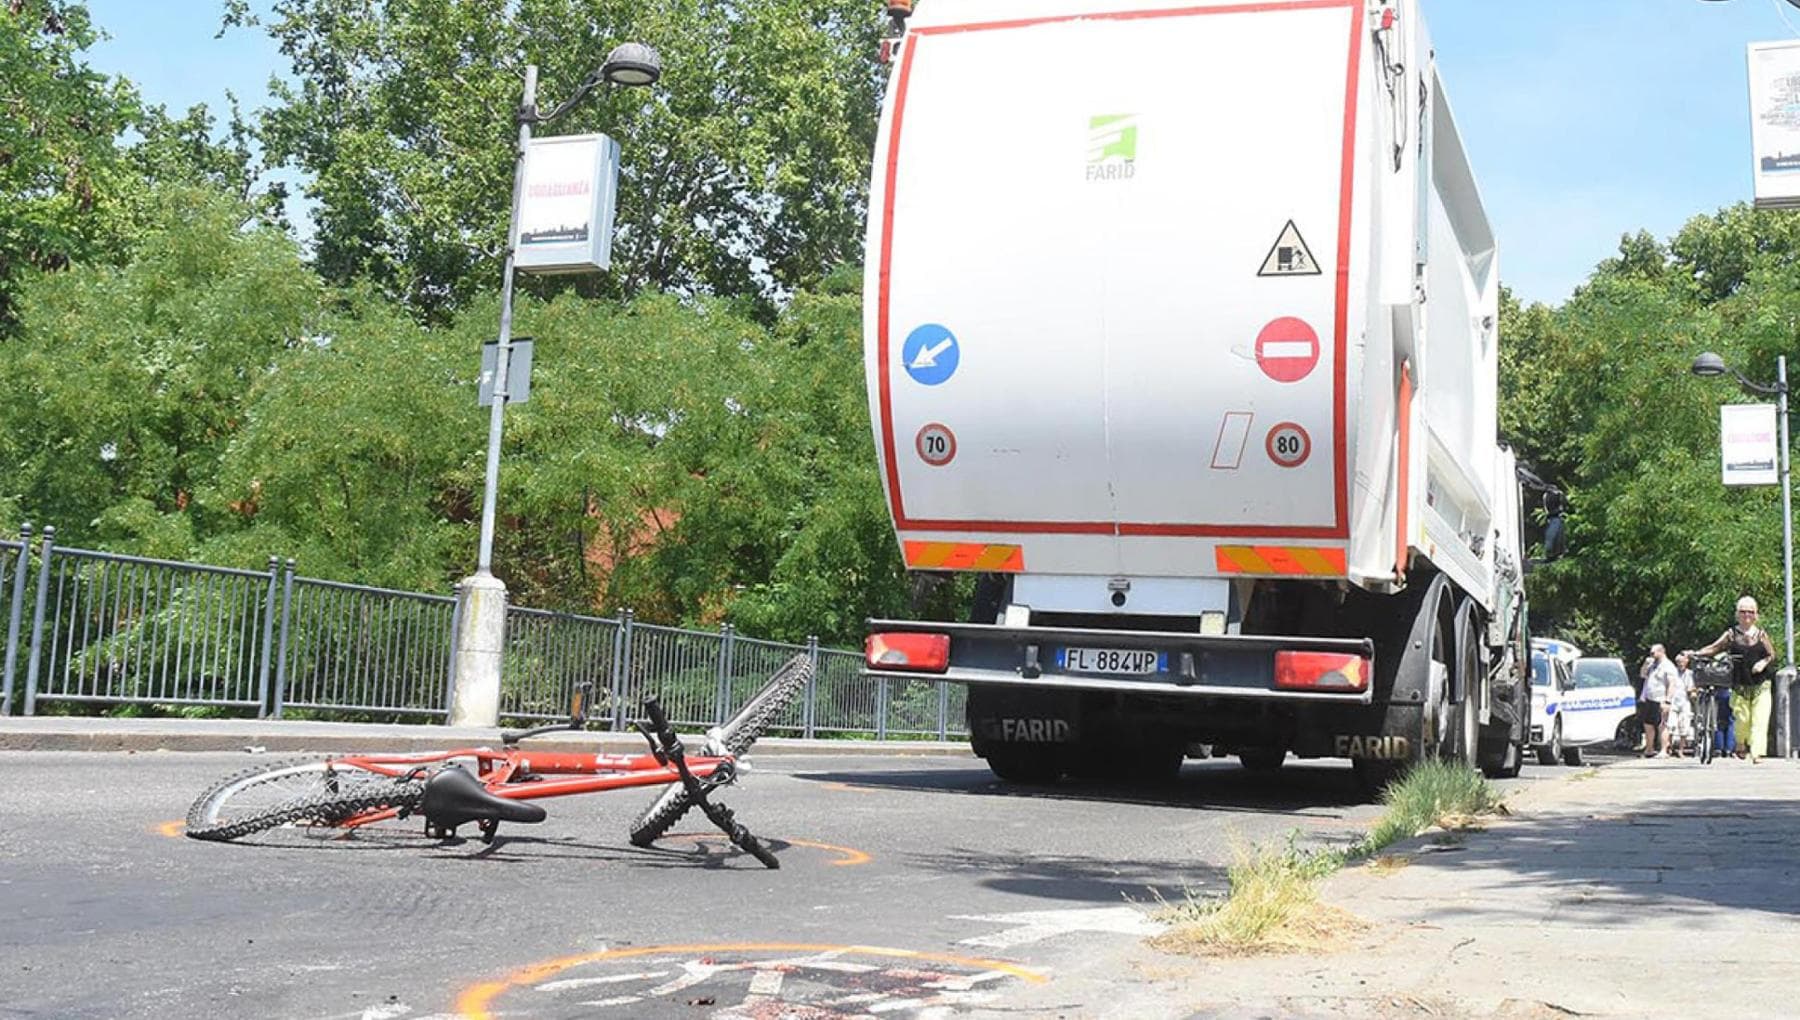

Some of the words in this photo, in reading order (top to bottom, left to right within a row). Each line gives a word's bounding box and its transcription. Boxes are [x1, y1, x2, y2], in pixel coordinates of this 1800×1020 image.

[1085, 163, 1135, 181] FARID
[926, 436, 945, 454] 70
[1277, 435, 1299, 454] 80
[1066, 649, 1089, 670] FL
[1096, 650, 1156, 672] 884WP
[1001, 718, 1070, 743] FARID
[1334, 735, 1409, 759] FARID
